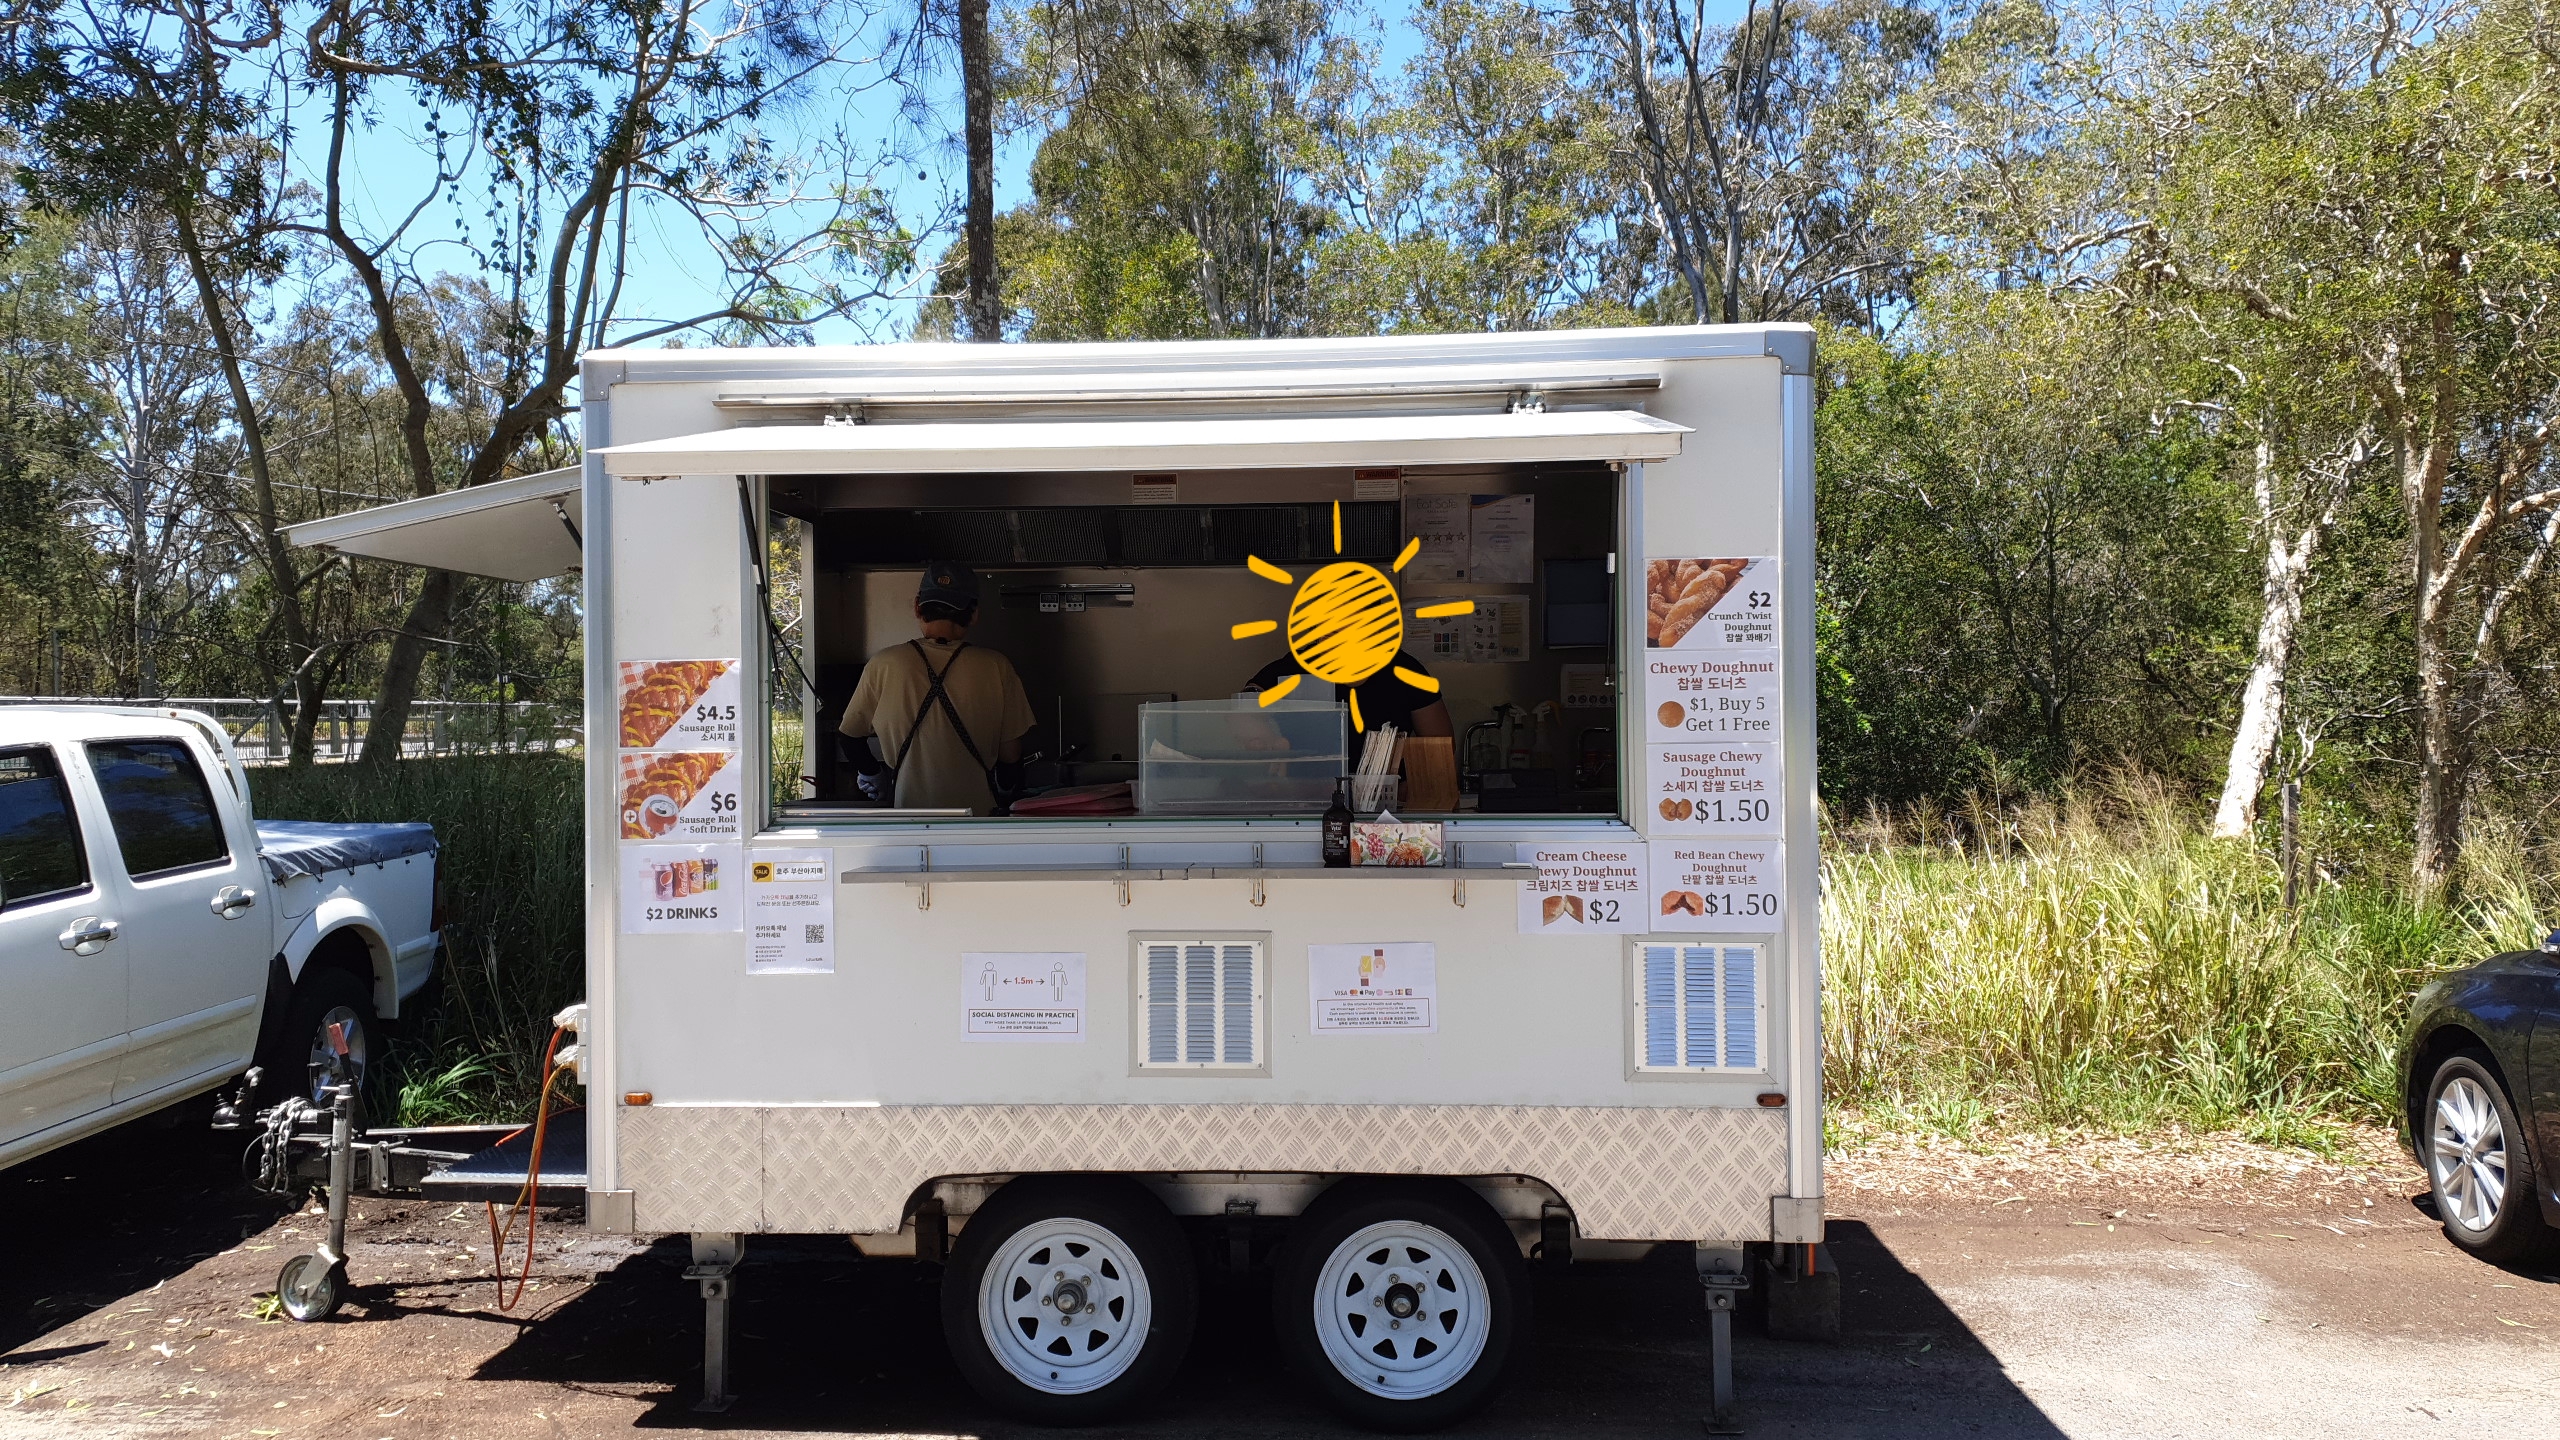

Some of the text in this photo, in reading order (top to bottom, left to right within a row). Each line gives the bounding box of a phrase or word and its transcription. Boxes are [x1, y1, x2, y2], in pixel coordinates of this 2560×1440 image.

[1748, 590, 1771, 609] $2
[1708, 612, 1772, 620] Crunch Twist
[1724, 623, 1772, 633] Doughnut
[1726, 633, 1771, 642] 찹쌀 꽈배기
[1650, 661, 1774, 676] Chewy Doughnut
[1677, 677, 1747, 690] 찹쌀 도너츠
[1690, 696, 1765, 714] $1, Buy 5
[696, 704, 735, 723] $4.5
[679, 723, 735, 733] Sausage Roll
[1686, 717, 1770, 731] Get 1 Free
[701, 733, 724, 741] 소시지
[1663, 751, 1762, 764] Sausage Chewy
[1680, 766, 1746, 779] Doughnut
[1662, 780, 1764, 793] 소세지 찹쌀 도너츠
[711, 791, 737, 814] $6
[1695, 799, 1769, 824] $1.50
[679, 815, 736, 825] Sausage Roll
[690, 825, 707, 833] Soft
[710, 825, 736, 833] Drink
[1536, 851, 1627, 861] Cream Cheese
[1674, 850, 1765, 862] Red Bean Chewy
[776, 867, 789, 875] 호주
[1537, 866, 1637, 878] hewy Doughnut
[1692, 863, 1747, 874] Doughnut
[1682, 874, 1758, 885] 단팥 찹쌀 도너츠
[1526, 880, 1638, 892] 크림치즈 찹쌀 도너츠
[1705, 892, 1777, 917] $1.50
[646, 907, 718, 921] $2 DRINKS
[1589, 899, 1620, 924] $2
[1014, 977, 1033, 985] 1.5m
